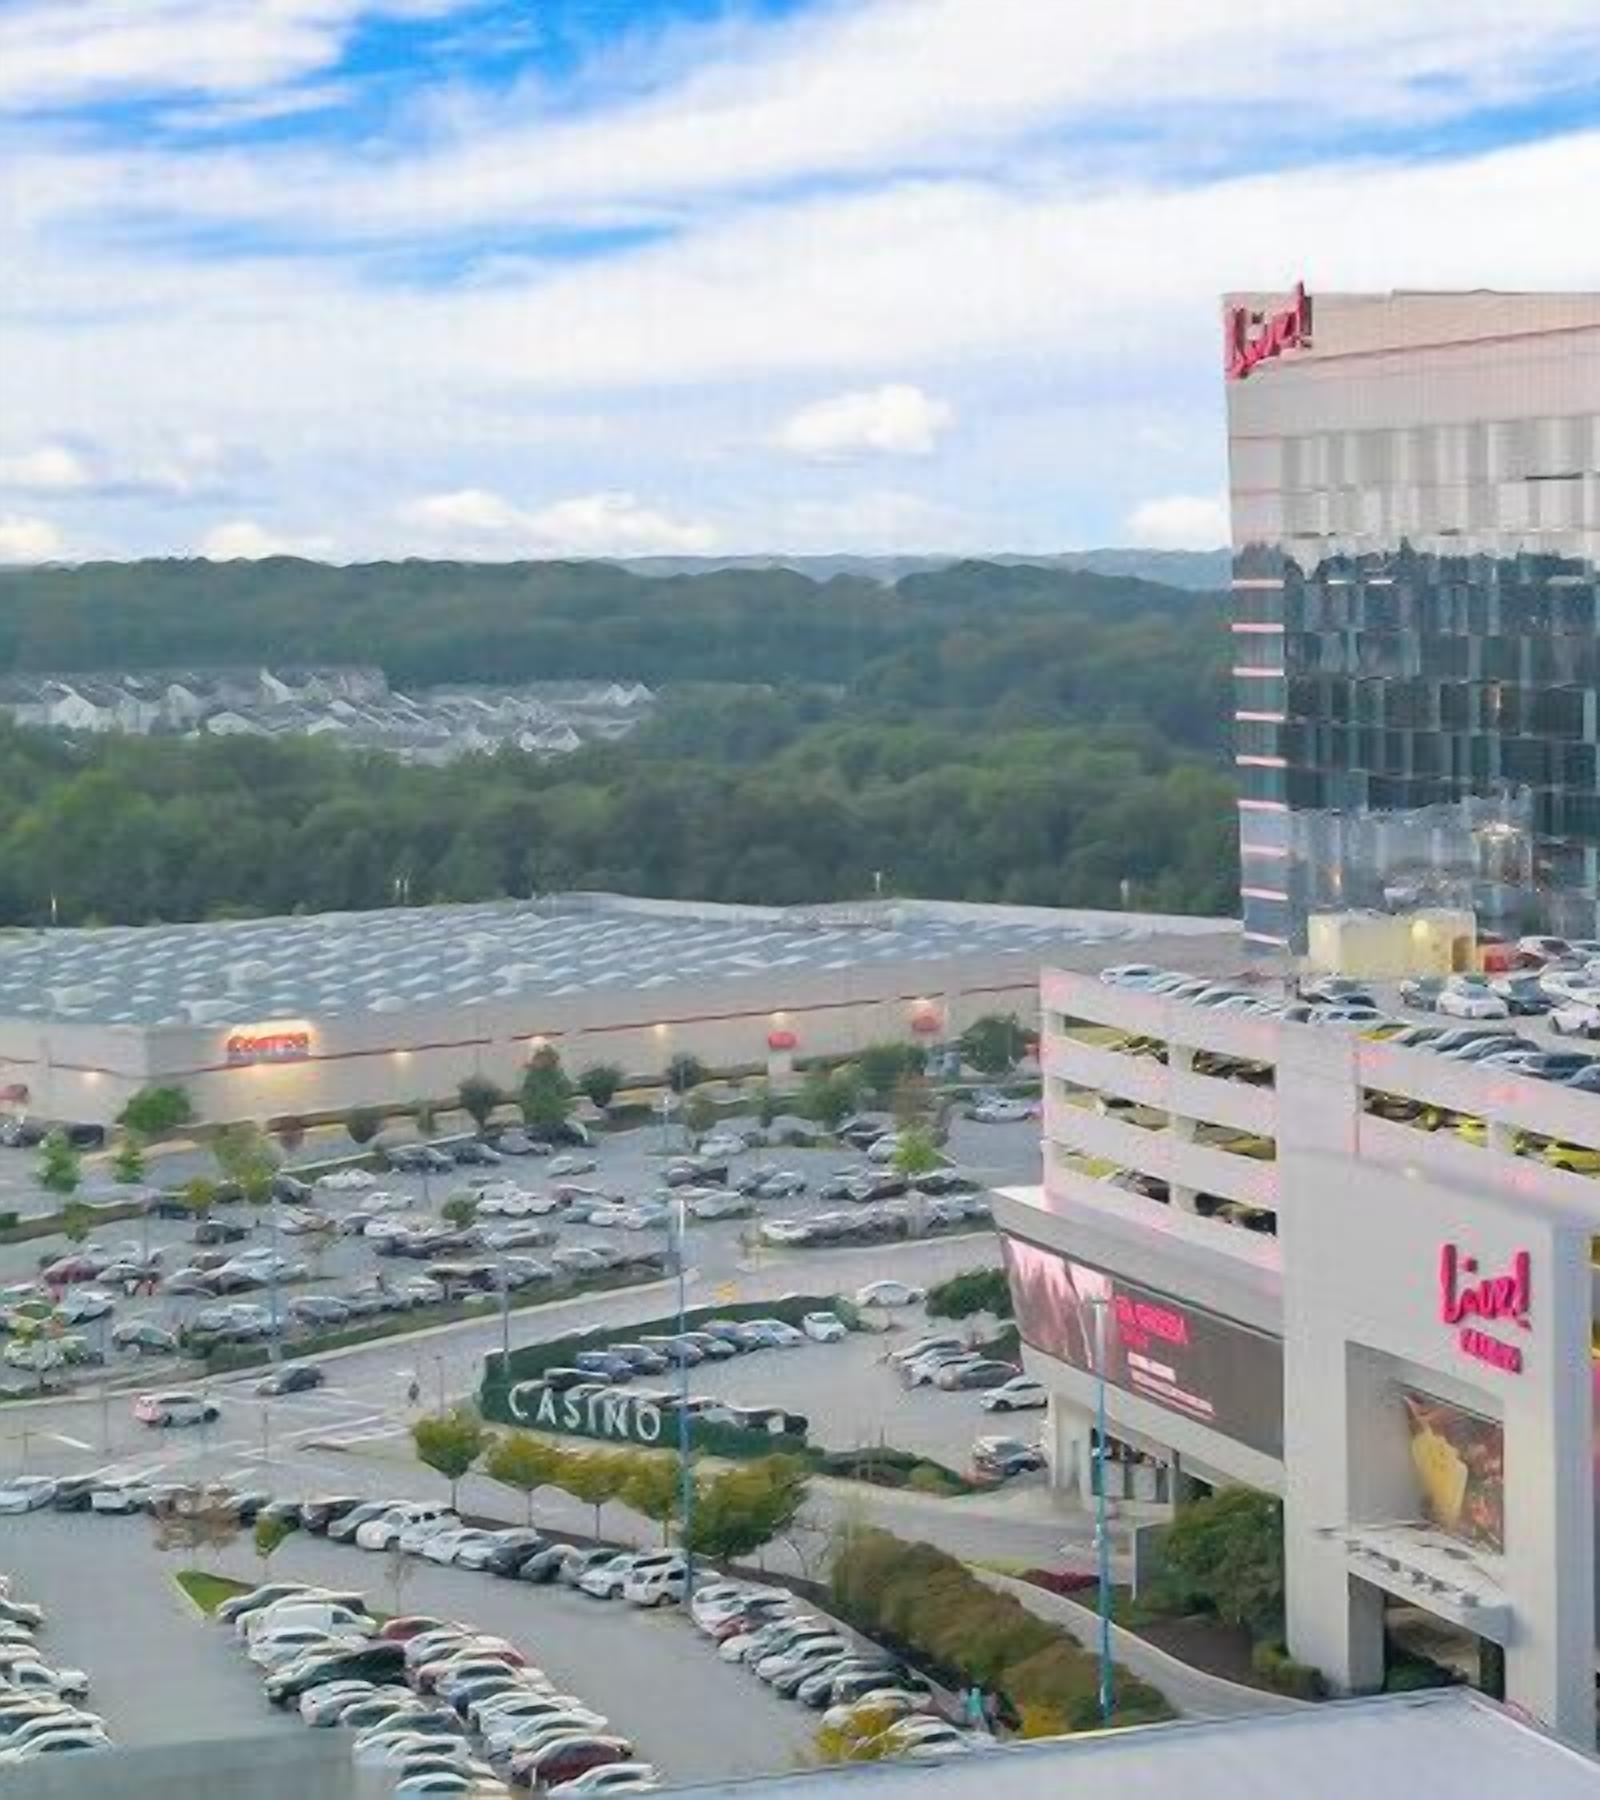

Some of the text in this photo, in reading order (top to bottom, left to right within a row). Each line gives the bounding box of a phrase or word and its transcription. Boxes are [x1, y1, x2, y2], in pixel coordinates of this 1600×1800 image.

[1225, 281, 1312, 378] Live!
[1441, 1244, 1531, 1330] Live!
[508, 1382, 661, 1441] CASINO
